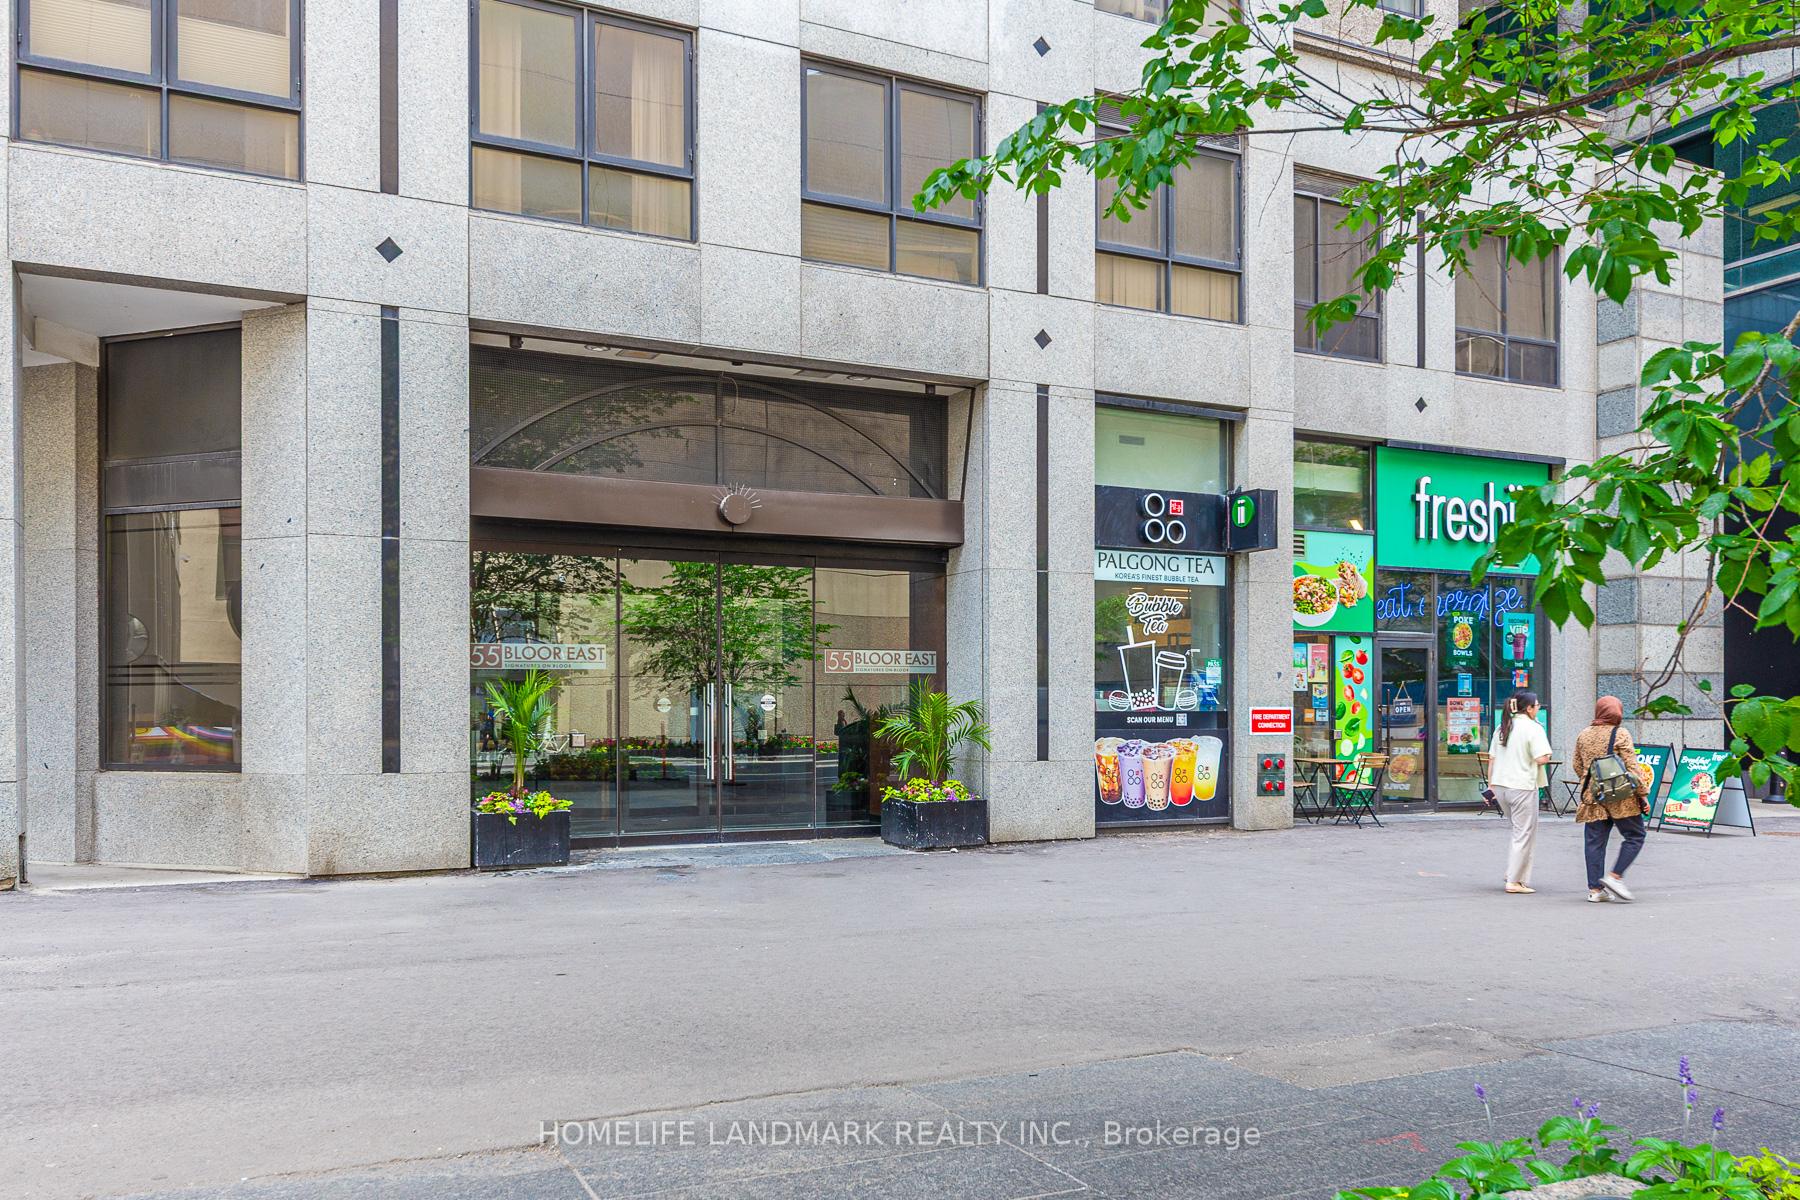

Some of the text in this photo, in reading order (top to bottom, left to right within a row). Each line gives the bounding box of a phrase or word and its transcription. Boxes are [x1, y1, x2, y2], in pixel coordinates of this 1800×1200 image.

[1097, 551, 1215, 575] PALGONG TEA
[1114, 572, 1140, 580] KOREA'S
[1164, 575, 1186, 583] BUBBLE
[1126, 592, 1184, 616] Bubble
[1139, 612, 1169, 636] Tea
[1453, 616, 1474, 625] POKE
[470, 646, 605, 666] 55 BLOOR EAST
[828, 652, 936, 671] 55 BLOOR EAST
[1453, 649, 1473, 657] BOWLS
[1636, 754, 1661, 765] OKE
